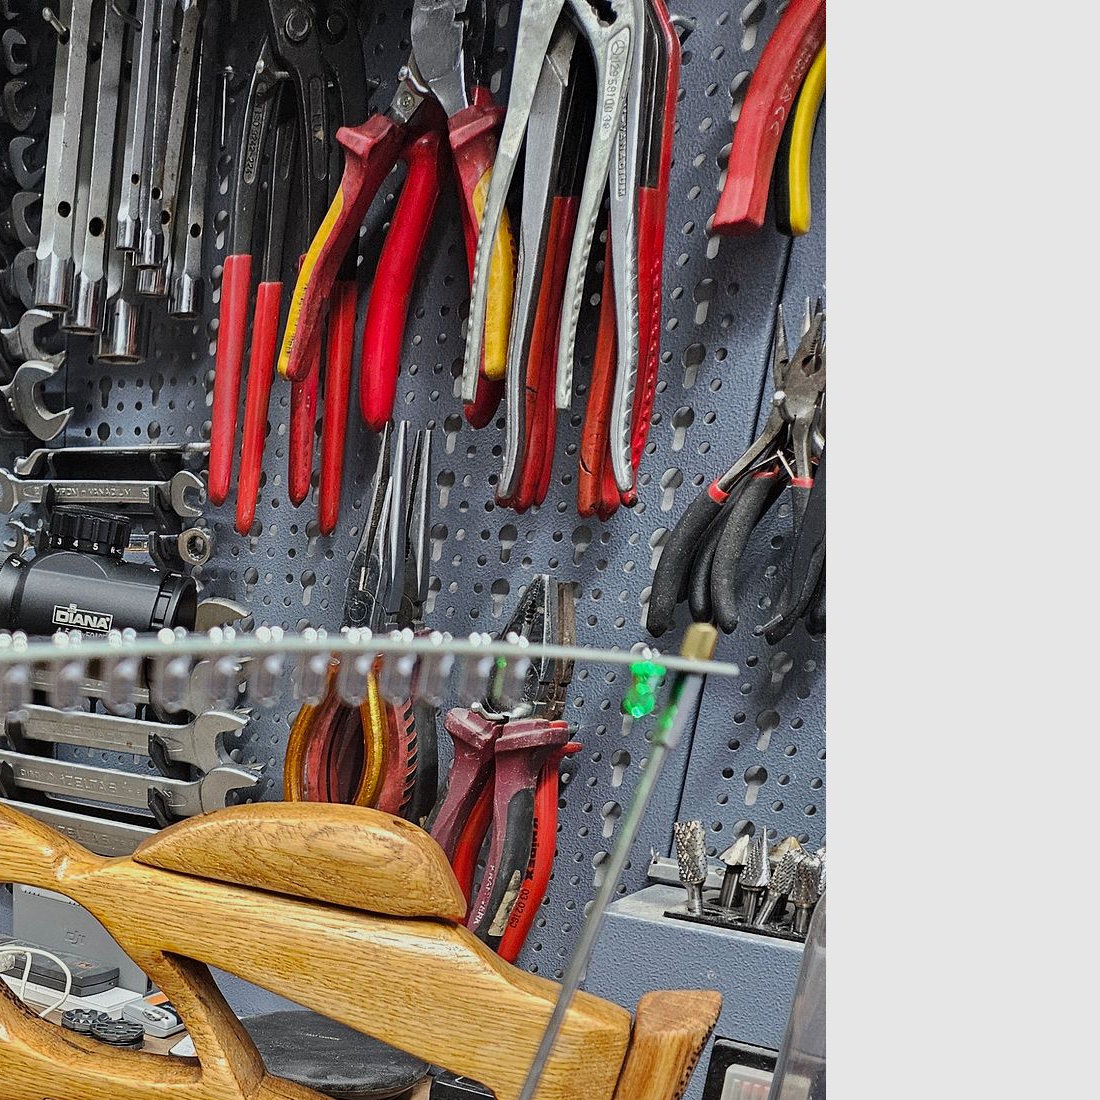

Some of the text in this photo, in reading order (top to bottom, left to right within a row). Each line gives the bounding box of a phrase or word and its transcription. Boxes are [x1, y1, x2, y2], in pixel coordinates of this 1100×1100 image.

[55, 609, 109, 630] DIANA
[525, 817, 540, 881] KNIPEX
[516, 901, 526, 914] 02
